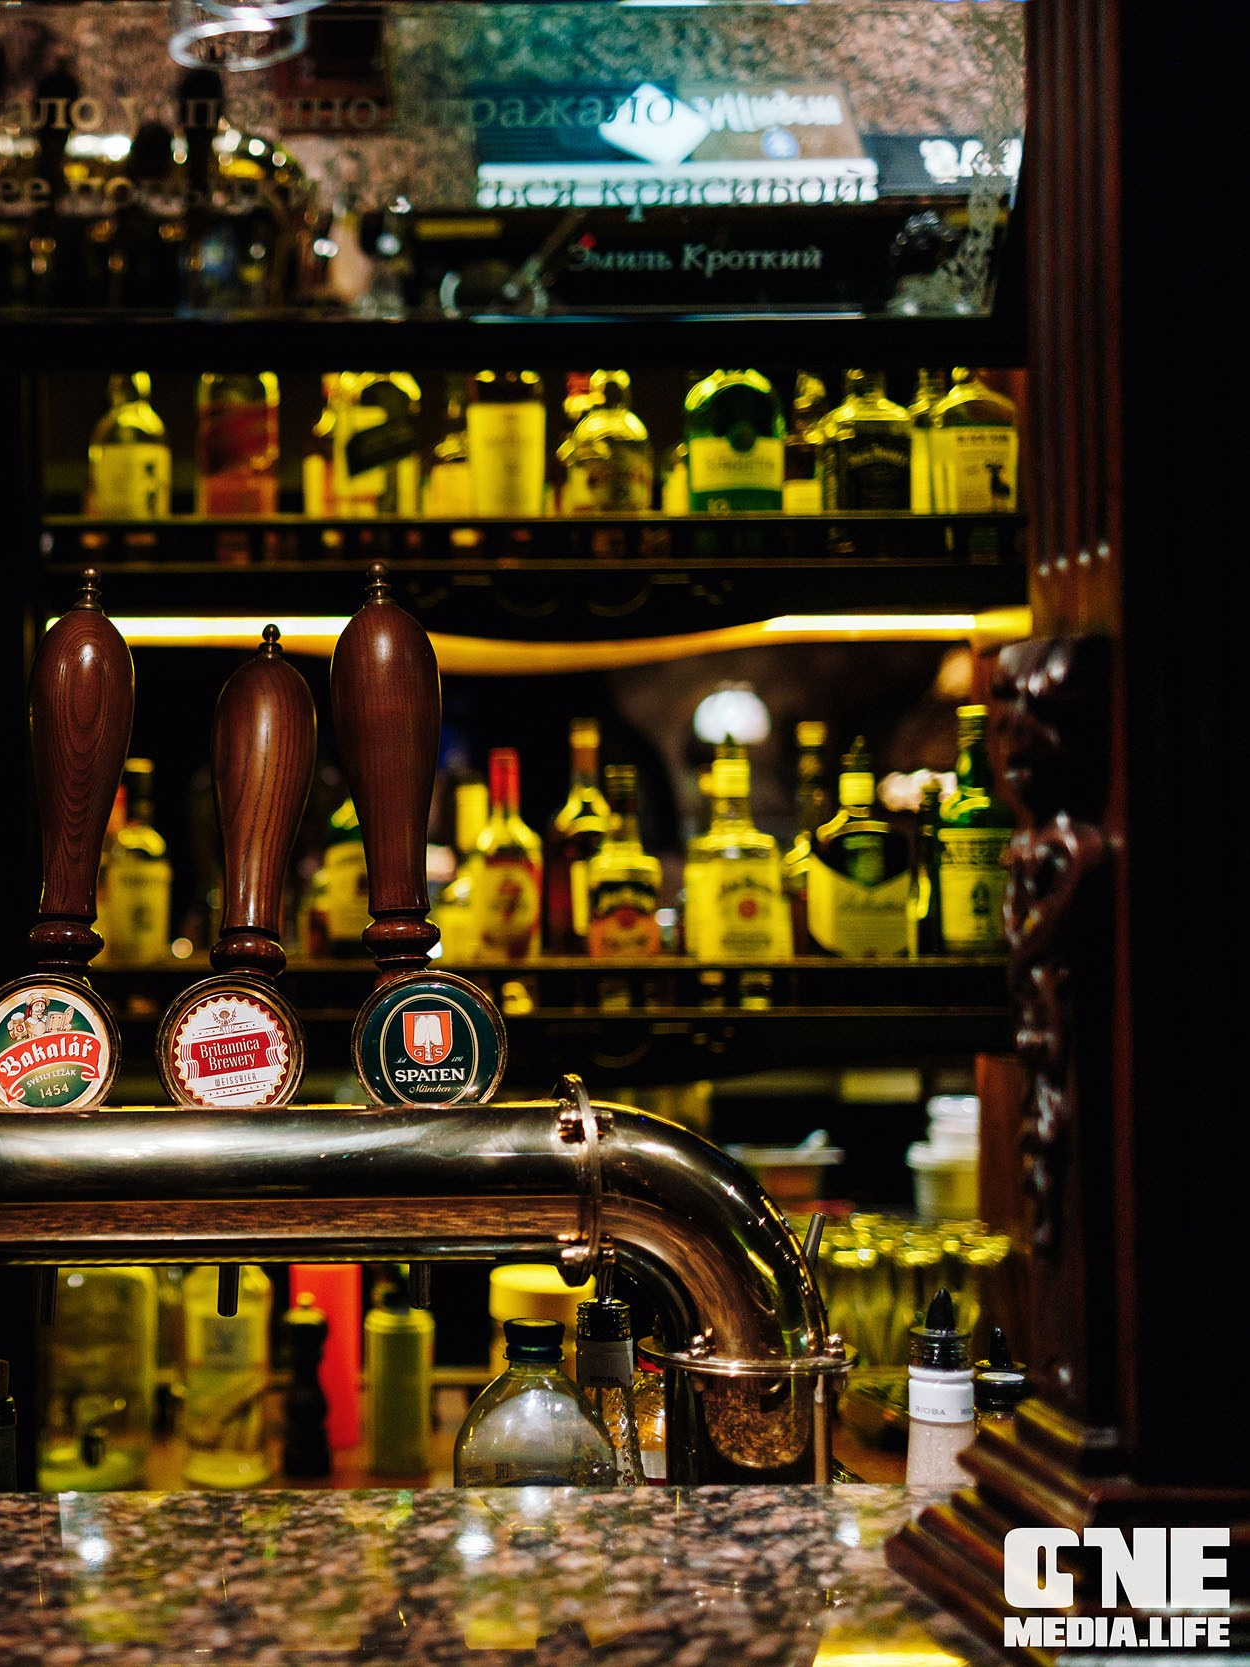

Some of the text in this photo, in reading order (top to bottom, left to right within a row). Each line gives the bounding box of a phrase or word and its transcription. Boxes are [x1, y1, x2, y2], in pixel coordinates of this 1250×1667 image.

[569, 242, 823, 278] Эмиль Кроткий
[199, 1036, 261, 1060] Britannica
[413, 1047, 444, 1057] G S
[208, 1051, 256, 1071] Brewery
[214, 1072, 258, 1088] WEISSBIER
[394, 1067, 466, 1083] SPATEN
[39, 1082, 70, 1099] 1454
[408, 1083, 452, 1094] München
[914, 1405, 946, 1416] RIOBA
